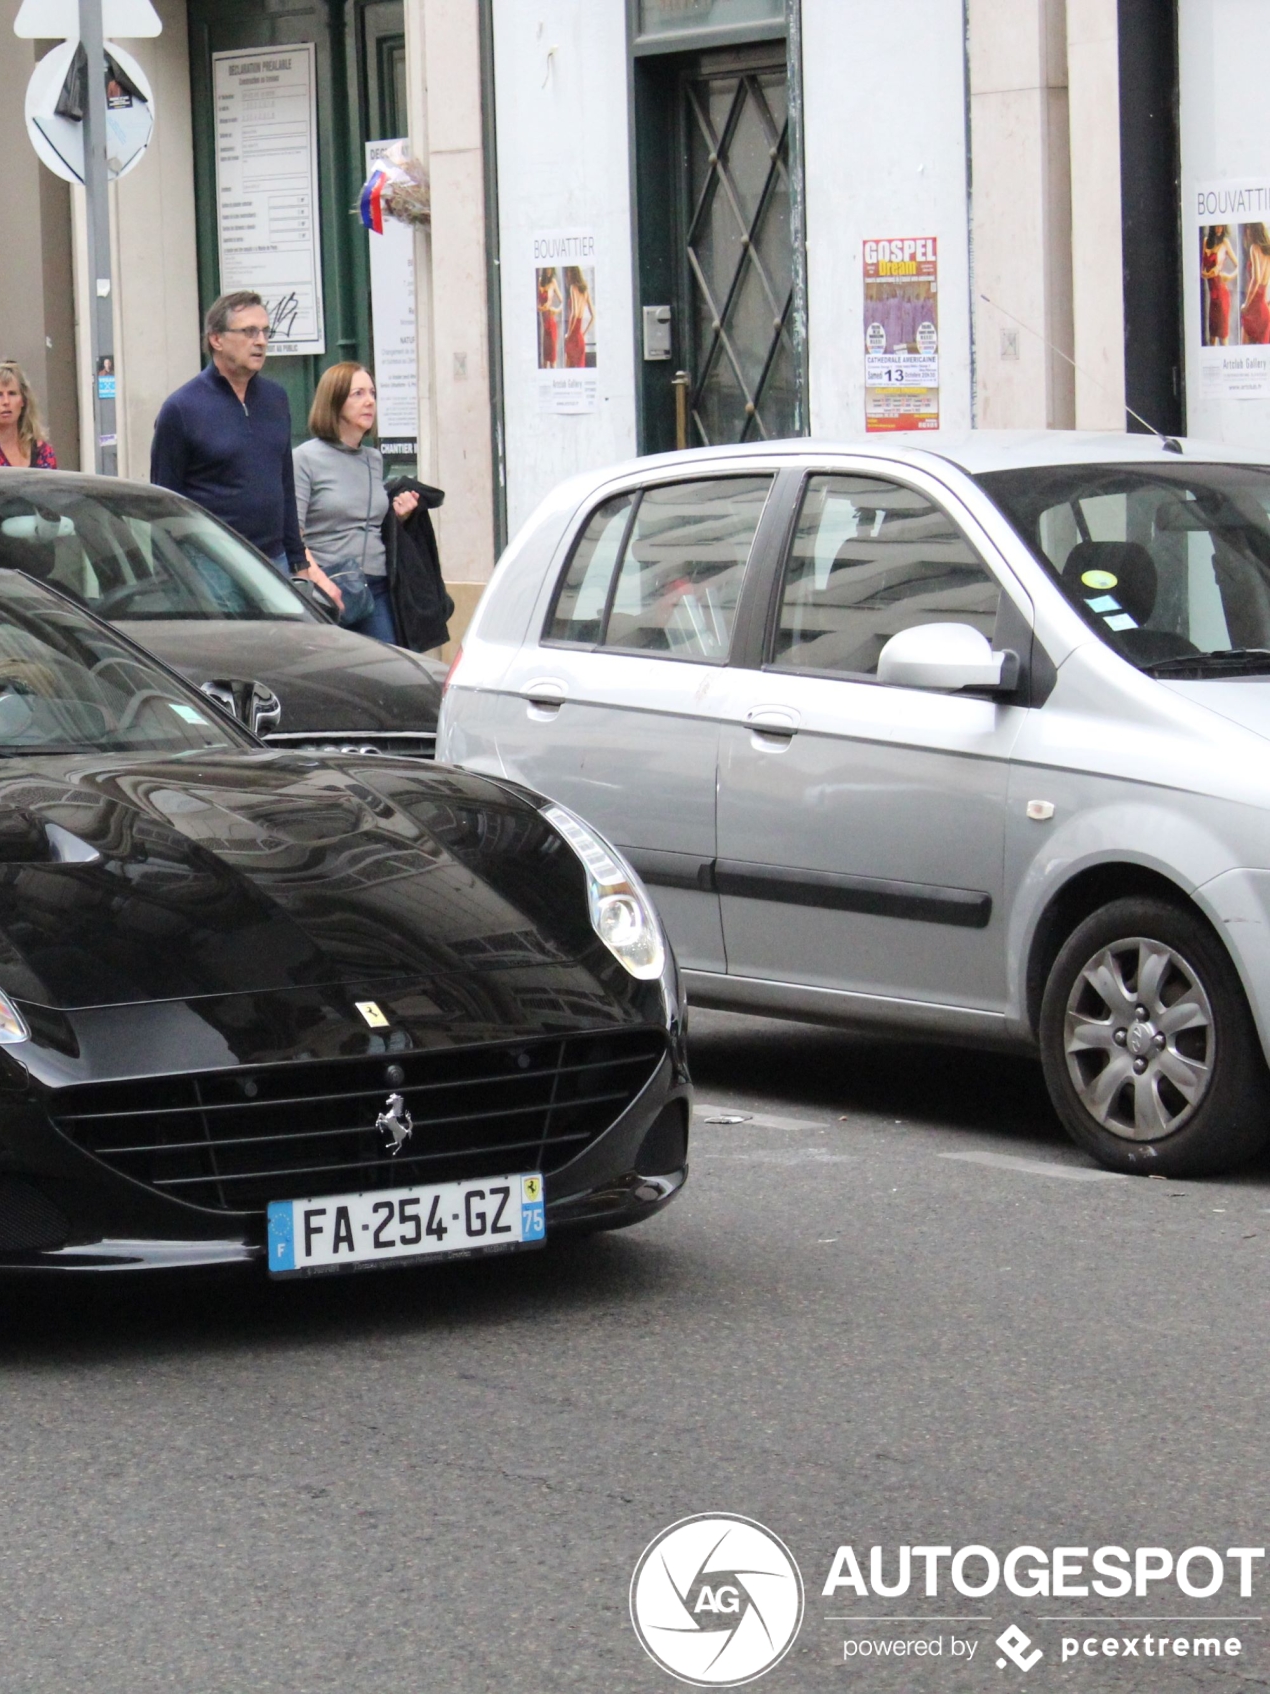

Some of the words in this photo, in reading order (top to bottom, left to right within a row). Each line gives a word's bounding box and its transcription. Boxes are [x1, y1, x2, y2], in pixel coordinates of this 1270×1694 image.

[1197, 187, 1270, 216] BOUVATTI
[534, 236, 595, 259] BOUVATTIER
[864, 239, 936, 264] GOSPEL
[878, 259, 917, 276] Dream
[867, 356, 901, 364] CATHEDRALE
[902, 355, 936, 363] AMERICAINE
[1246, 357, 1266, 370] Gallery
[884, 368, 904, 382] 13
[380, 443, 413, 455] CHANTIER
[303, 1185, 512, 1257] FA-254-GZ
[522, 1208, 544, 1233] 75
[276, 1243, 285, 1258] F
